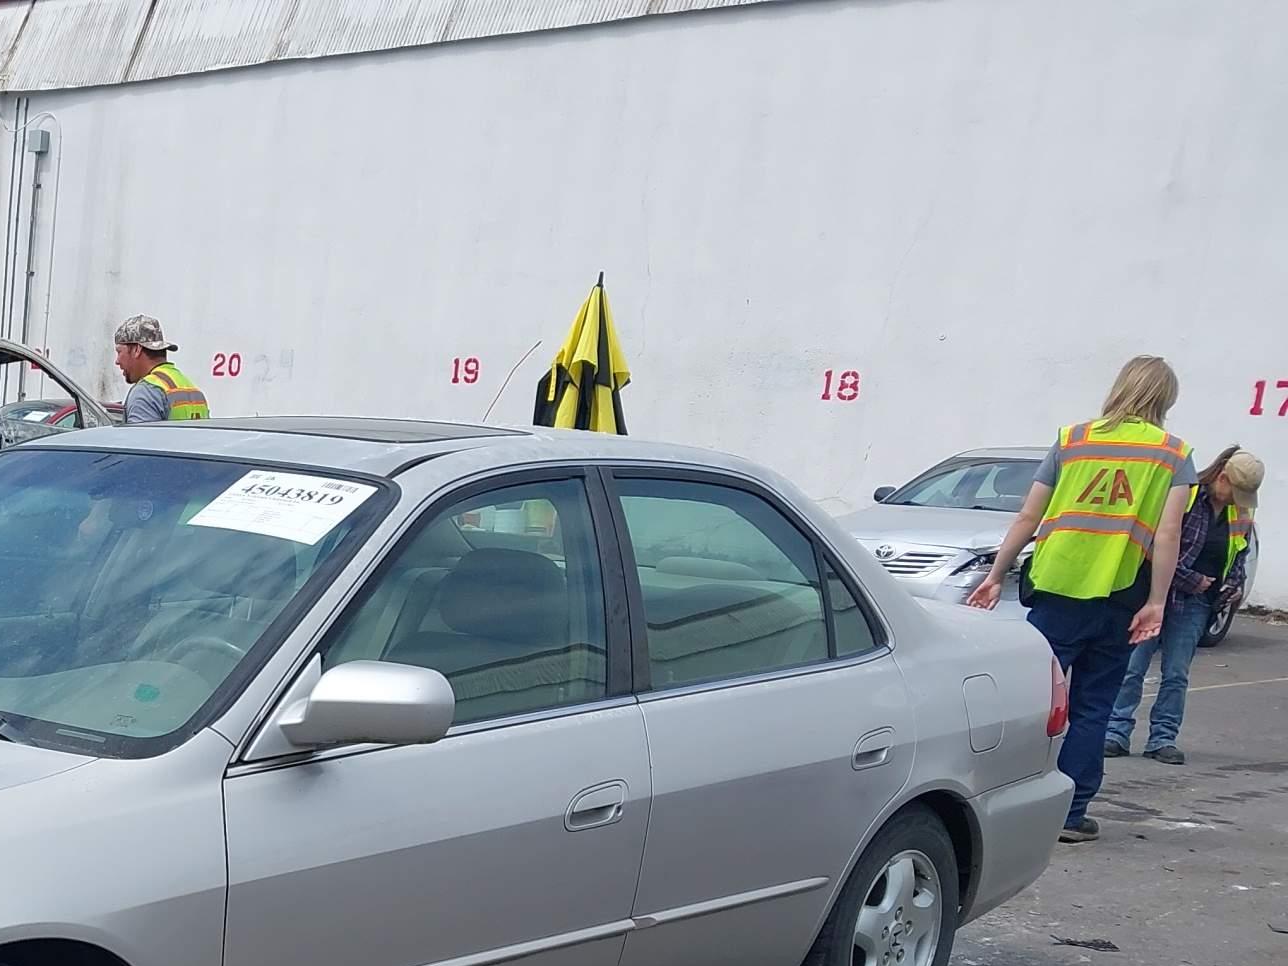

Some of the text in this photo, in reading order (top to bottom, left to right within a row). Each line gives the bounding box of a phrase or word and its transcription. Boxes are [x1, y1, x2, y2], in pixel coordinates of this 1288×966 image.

[212, 352, 241, 377] 20
[451, 357, 480, 384] 19
[821, 369, 860, 401] 18
[241, 482, 344, 506] 45043819
